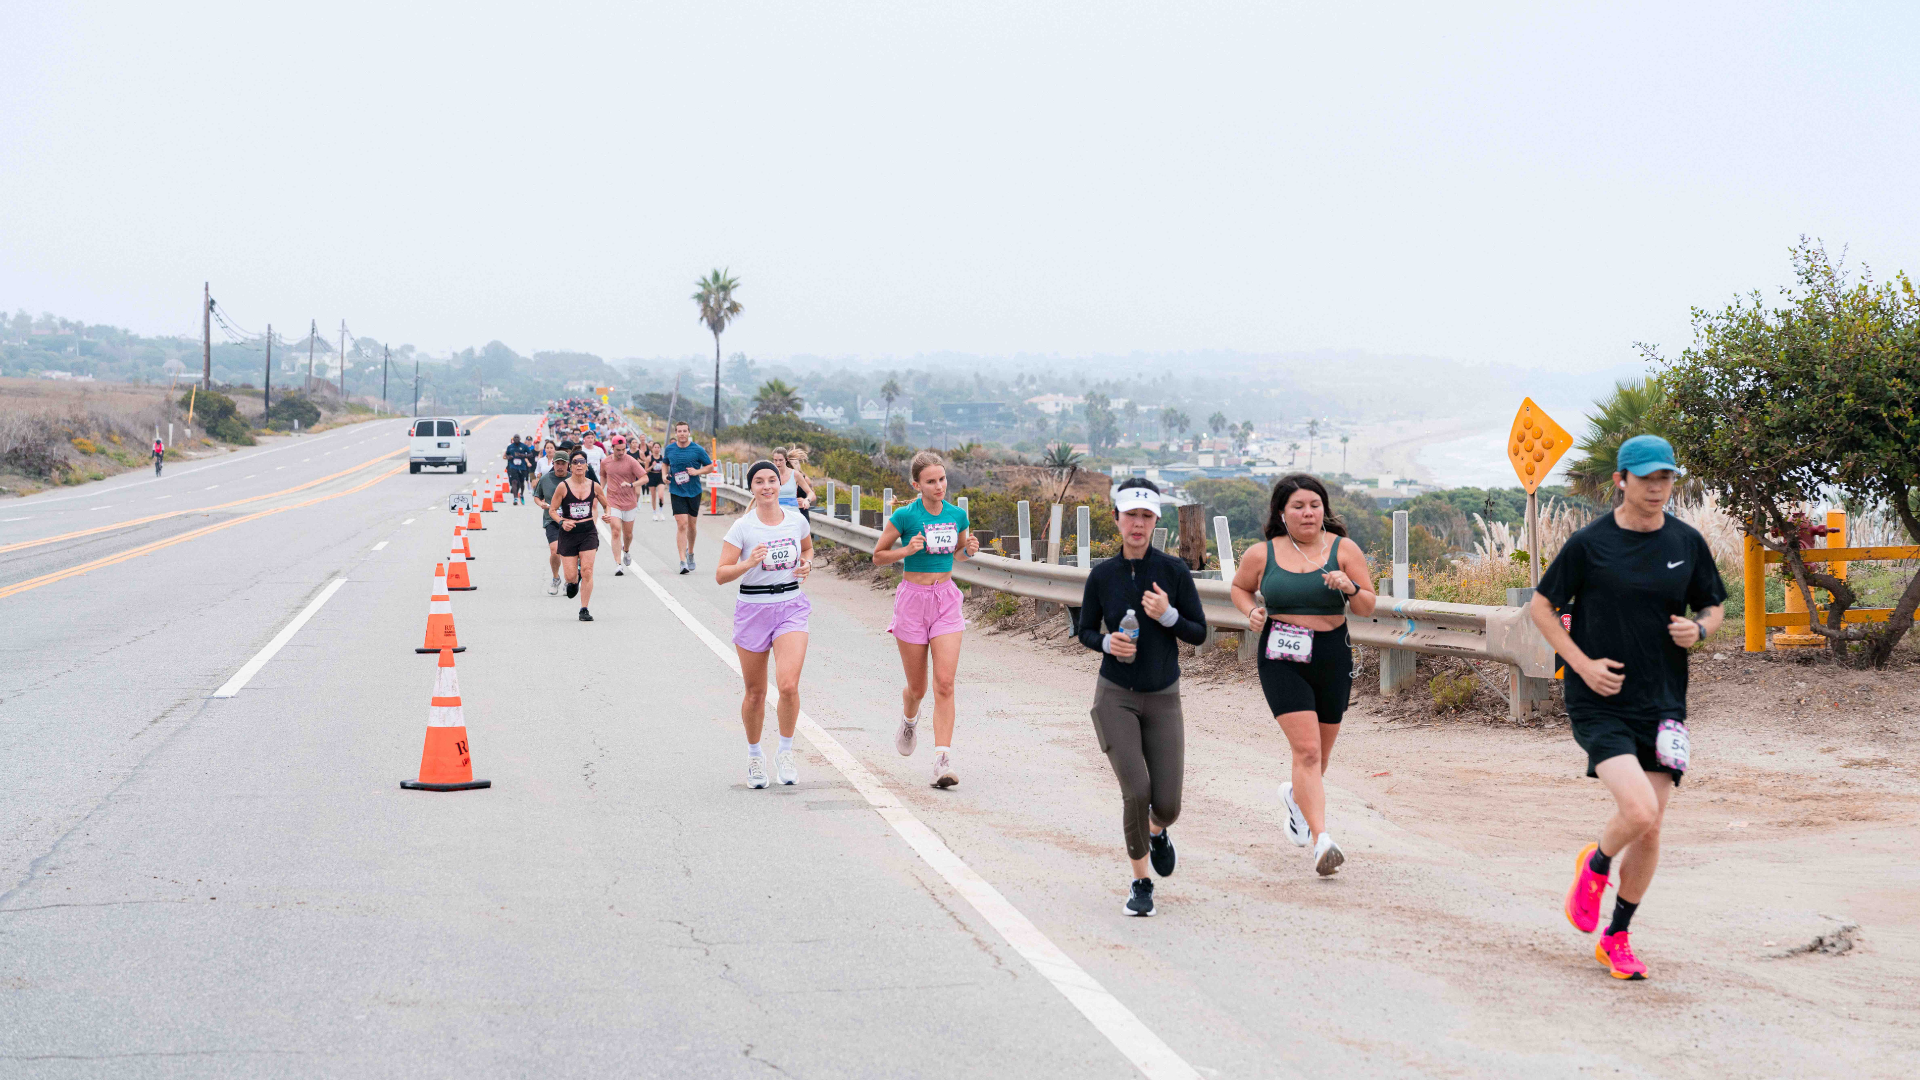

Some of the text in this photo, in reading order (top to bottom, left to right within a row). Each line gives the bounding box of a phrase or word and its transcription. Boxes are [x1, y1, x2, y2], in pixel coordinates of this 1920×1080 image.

[934, 535, 952, 544] 742
[771, 550, 790, 560] 602
[1277, 638, 1301, 651] 946
